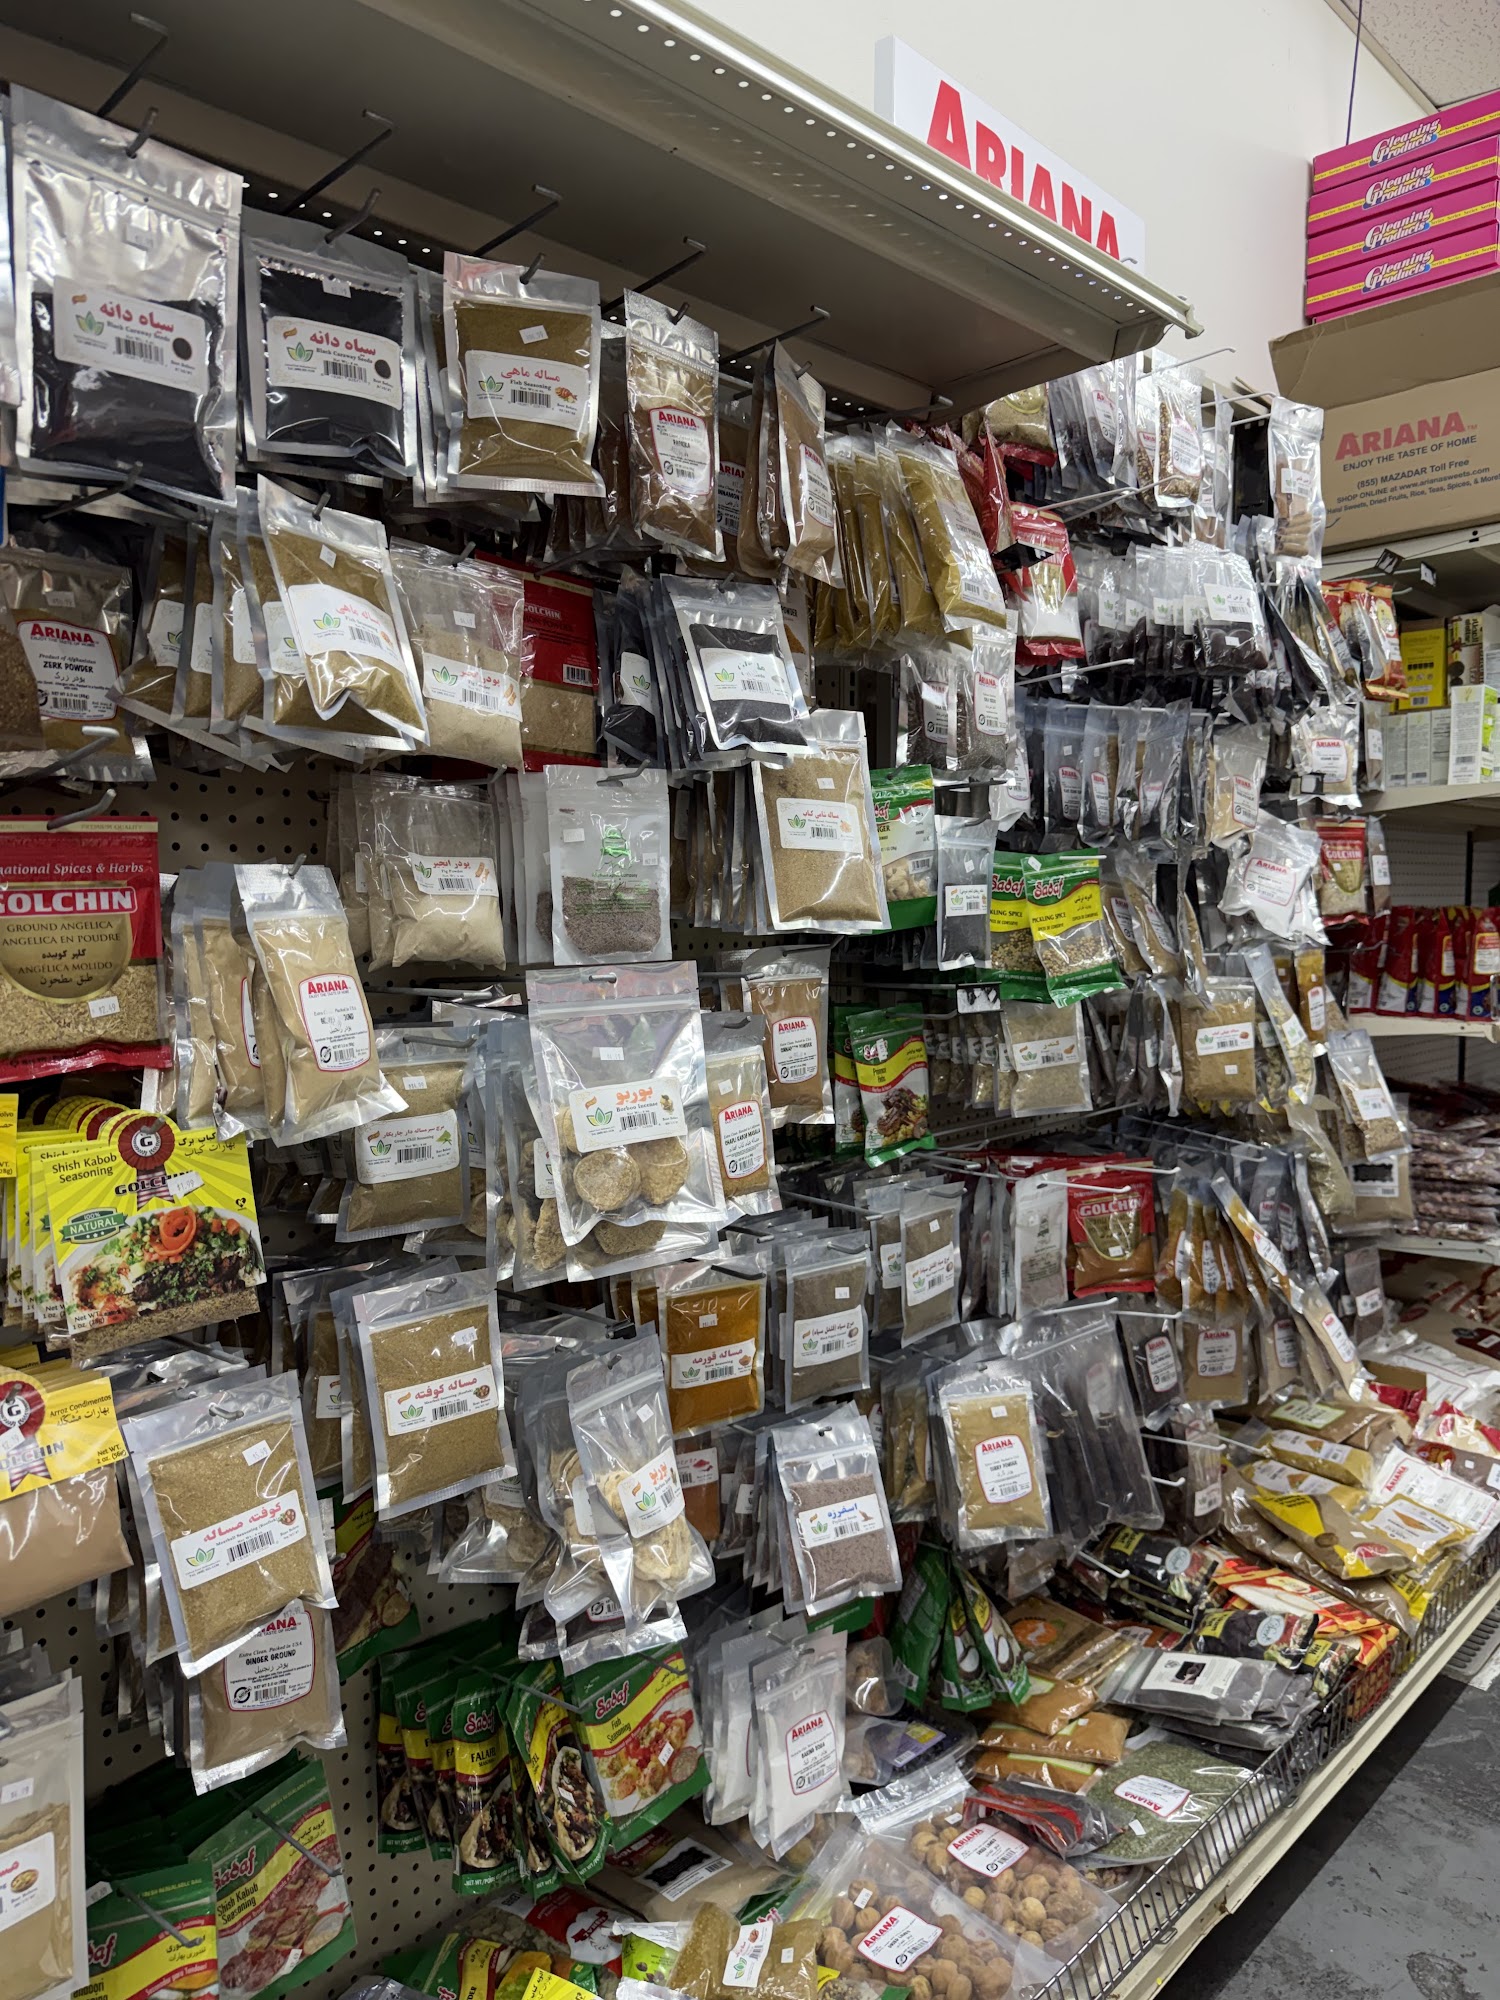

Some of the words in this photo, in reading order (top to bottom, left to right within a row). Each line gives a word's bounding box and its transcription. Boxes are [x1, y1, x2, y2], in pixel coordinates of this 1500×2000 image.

[1371, 118, 1440, 163] Cleaning
[1378, 131, 1433, 163] Products
[927, 79, 1120, 261] ARIANA
[1365, 163, 1434, 206] Cleaning
[1371, 176, 1427, 206] Products
[1365, 207, 1433, 248] Cleaning
[1371, 220, 1425, 250] Products
[1365, 249, 1433, 290] Cleaning
[1371, 262, 1426, 292] Products
[107, 321, 124, 331] Black
[316, 347, 332, 356] Black
[523, 380, 552, 392] Seasoning
[658, 411, 698, 428] ARIANA
[1334, 411, 1466, 461] ARIANA
[1343, 459, 1373, 472] ENJOY
[1376, 453, 1395, 465] THE
[1397, 448, 1428, 461] TASTE
[1430, 443, 1444, 453] OF
[1446, 434, 1477, 449] HOME
[1356, 474, 1379, 490] (855)
[1380, 466, 1428, 484] MAZADAR
[1429, 462, 1447, 474] Toll
[1448, 457, 1470, 470] Free
[1336, 493, 1358, 504] SHOP
[1359, 488, 1389, 500] ONLINE
[1390, 485, 1398, 493] at
[1398, 466, 1490, 491] www.arianasweets.com
[1369, 496, 1387, 506] Dried
[1410, 488, 1427, 499] Rice,
[1428, 484, 1446, 496] Teas,
[1446, 479, 1472, 491] Spices,
[30, 623, 94, 644] ARIANA
[43, 661, 63, 670] ZERK
[64, 662, 94, 673] POWDER
[978, 674, 997, 686] ARIANA
[1326, 850, 1362, 859] GOLCHIN
[53, 863, 93, 876] Spices
[95, 863, 106, 874] &
[108, 862, 144, 874] Herbs
[1256, 860, 1288, 875] ARIANA
[991, 874, 1025, 898] Sadaf
[1033, 875, 1065, 899] Sadaf
[1008, 910, 1023, 918] SPICE
[1032, 913, 1055, 924] PICKLING
[1055, 911, 1067, 919] SPICE
[6, 921, 58, 933] GROUND
[60, 920, 113, 932] ANGELICA
[2, 934, 58, 947] ANGELICA
[60, 934, 73, 945] EN
[77, 932, 121, 943] POUDRE
[72, 961, 113, 971] MOLIDO
[307, 979, 349, 995] ARIANA
[777, 1020, 807, 1033] ARIANA
[723, 1104, 753, 1122] ARIANA
[52, 1160, 81, 1174] Shish
[83, 1152, 117, 1165] Kabob
[59, 1166, 114, 1184] Seasoning
[69, 1217, 118, 1235] NATURAL
[1147, 1339, 1166, 1350] ARIANA
[1203, 1331, 1230, 1340] ARIANA
[414, 1384, 445, 1400] کوفته
[447, 1377, 478, 1391] مساله
[49, 1407, 68, 1418] Arroz
[69, 1394, 112, 1411] Condimentos
[97, 1448, 108, 1457] Net
[108, 1444, 122, 1453] WT.
[981, 1438, 1013, 1453] ARIANA
[101, 1455, 111, 1463] oz.
[1002, 1460, 1018, 1470] POWDER
[1386, 1465, 1409, 1492] ARIANA
[248, 1501, 282, 1524] کوفته
[203, 1521, 244, 1543] مساله
[215, 1535, 236, 1547] Meatball
[236, 1526, 259, 1538] Seasoning
[261, 1616, 297, 1633] ANA
[245, 1655, 269, 1666] GINGER
[270, 1649, 297, 1661] GROUND
[268, 1645, 286, 1653] Packed
[595, 1680, 630, 1720] Sadaf
[464, 1711, 495, 1736] Sadaf
[610, 1717, 622, 1731] Fish
[791, 1716, 824, 1741] ARIANA
[606, 1722, 632, 1745] Seasoning
[470, 1747, 497, 1763] FALAFEL
[801, 1747, 815, 1759] BAKING
[815, 1741, 826, 1751] SODA
[1123, 1791, 1163, 1812] ARIANA
[952, 1827, 984, 1851] ARIANA
[216, 1894, 236, 1917] Shish
[235, 1882, 260, 1903] Kabob
[221, 1896, 257, 1925] Seasoning
[863, 1916, 898, 1948] ARIANA
[185, 1962, 208, 1975] Tandoori
